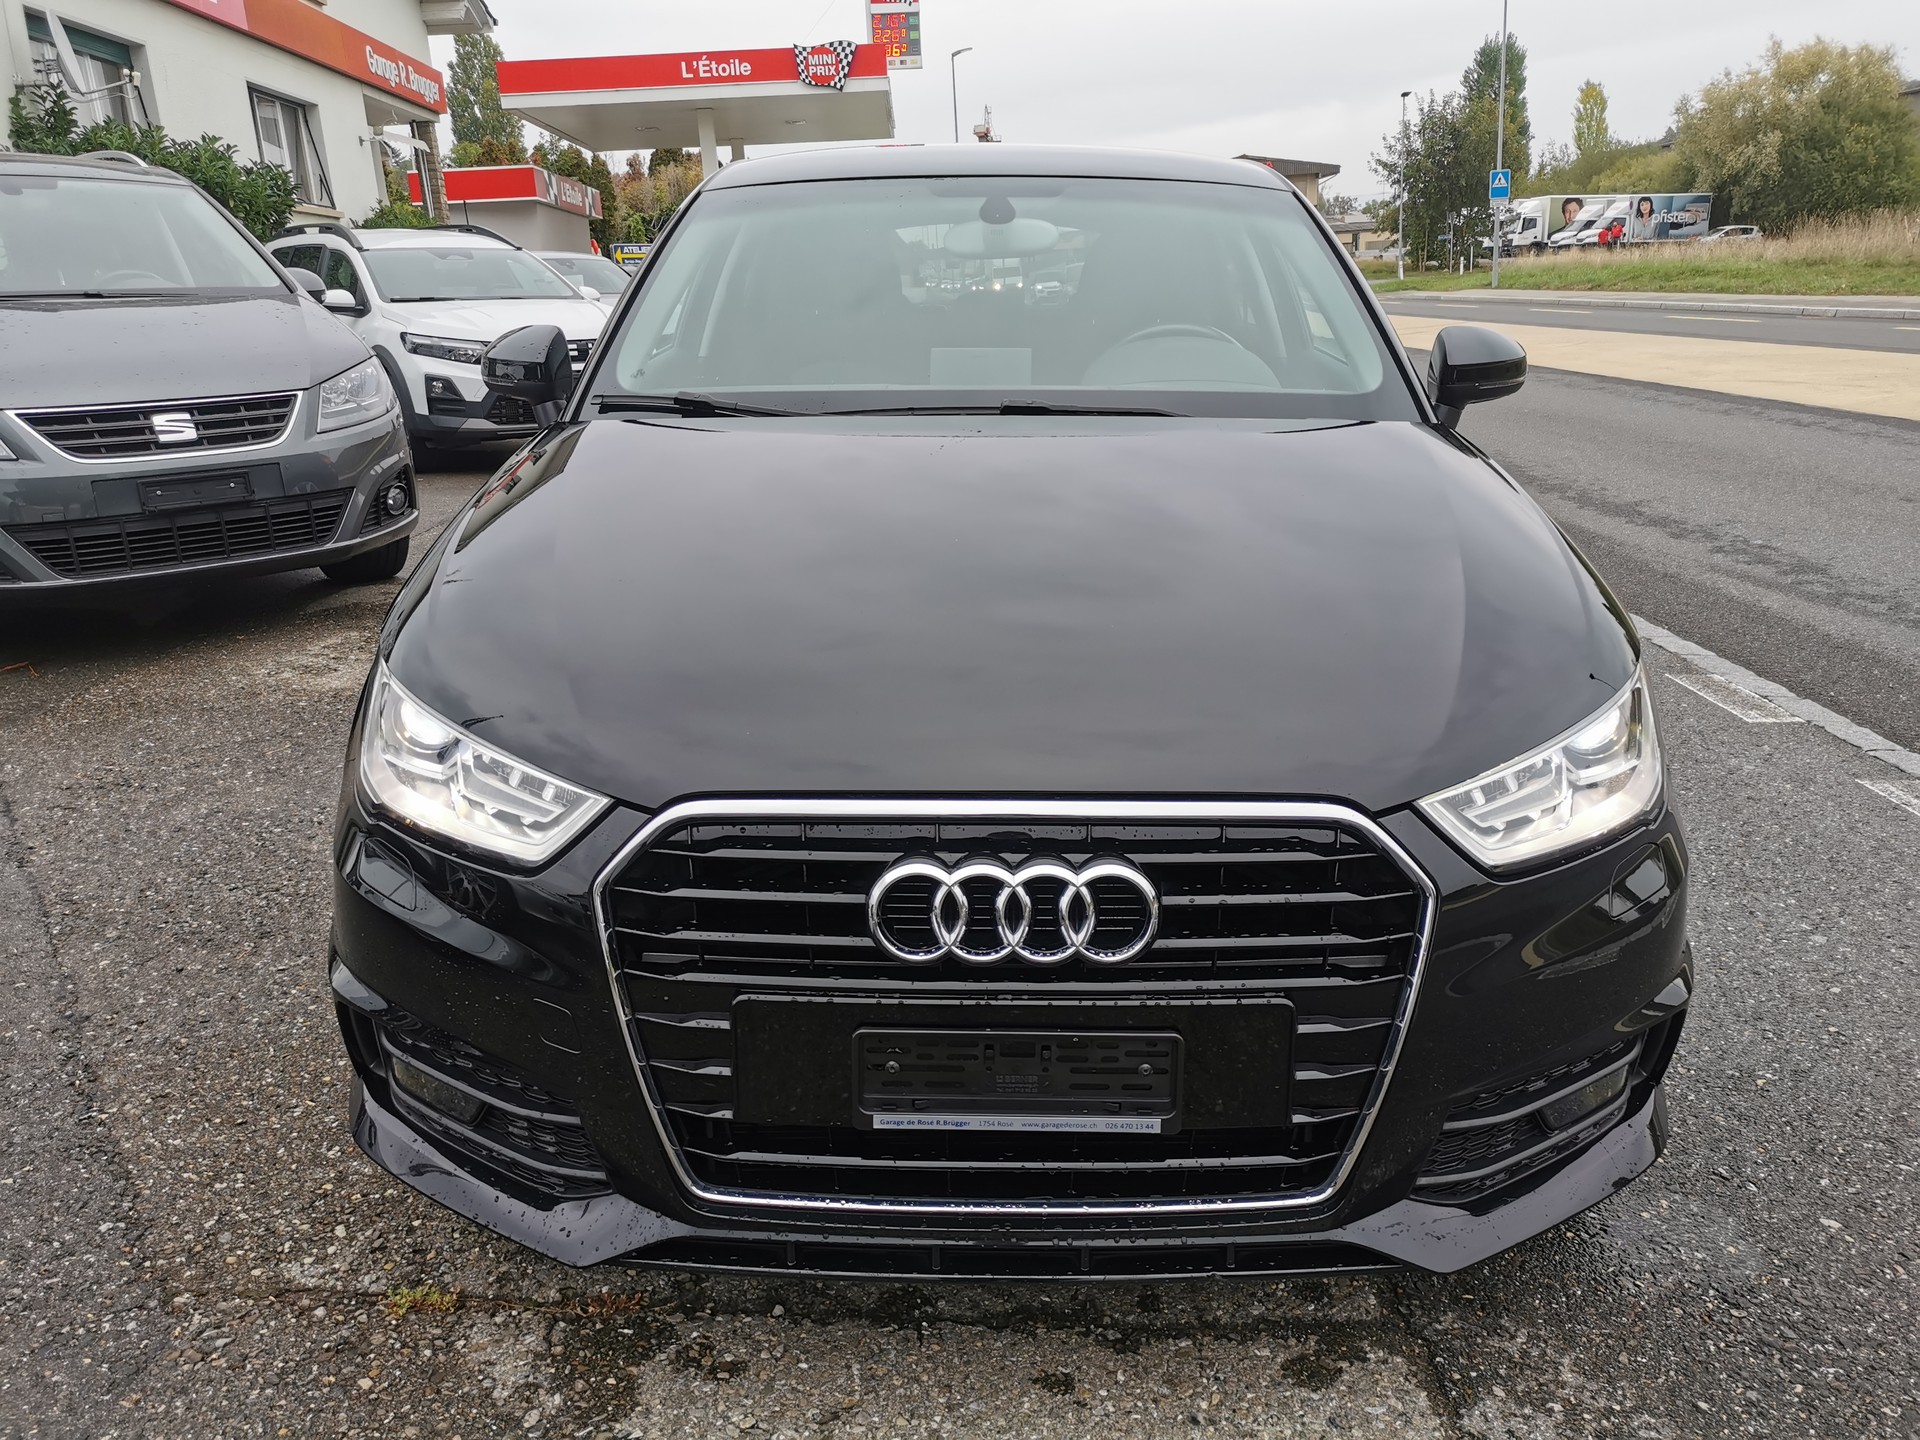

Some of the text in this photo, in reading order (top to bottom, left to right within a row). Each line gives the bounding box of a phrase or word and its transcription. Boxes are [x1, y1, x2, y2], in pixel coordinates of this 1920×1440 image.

[807, 54, 836, 66] MINI
[365, 45, 400, 88] Garage
[680, 55, 752, 79] L'Étoile
[808, 65, 837, 77] PRIX
[1651, 209, 1690, 227] pfister
[623, 246, 652, 254] ATELIE
[879, 1119, 905, 1127] Garage
[1021, 1121, 1098, 1129] www.garagederose.ch
[1120, 1122, 1134, 1130] 470
